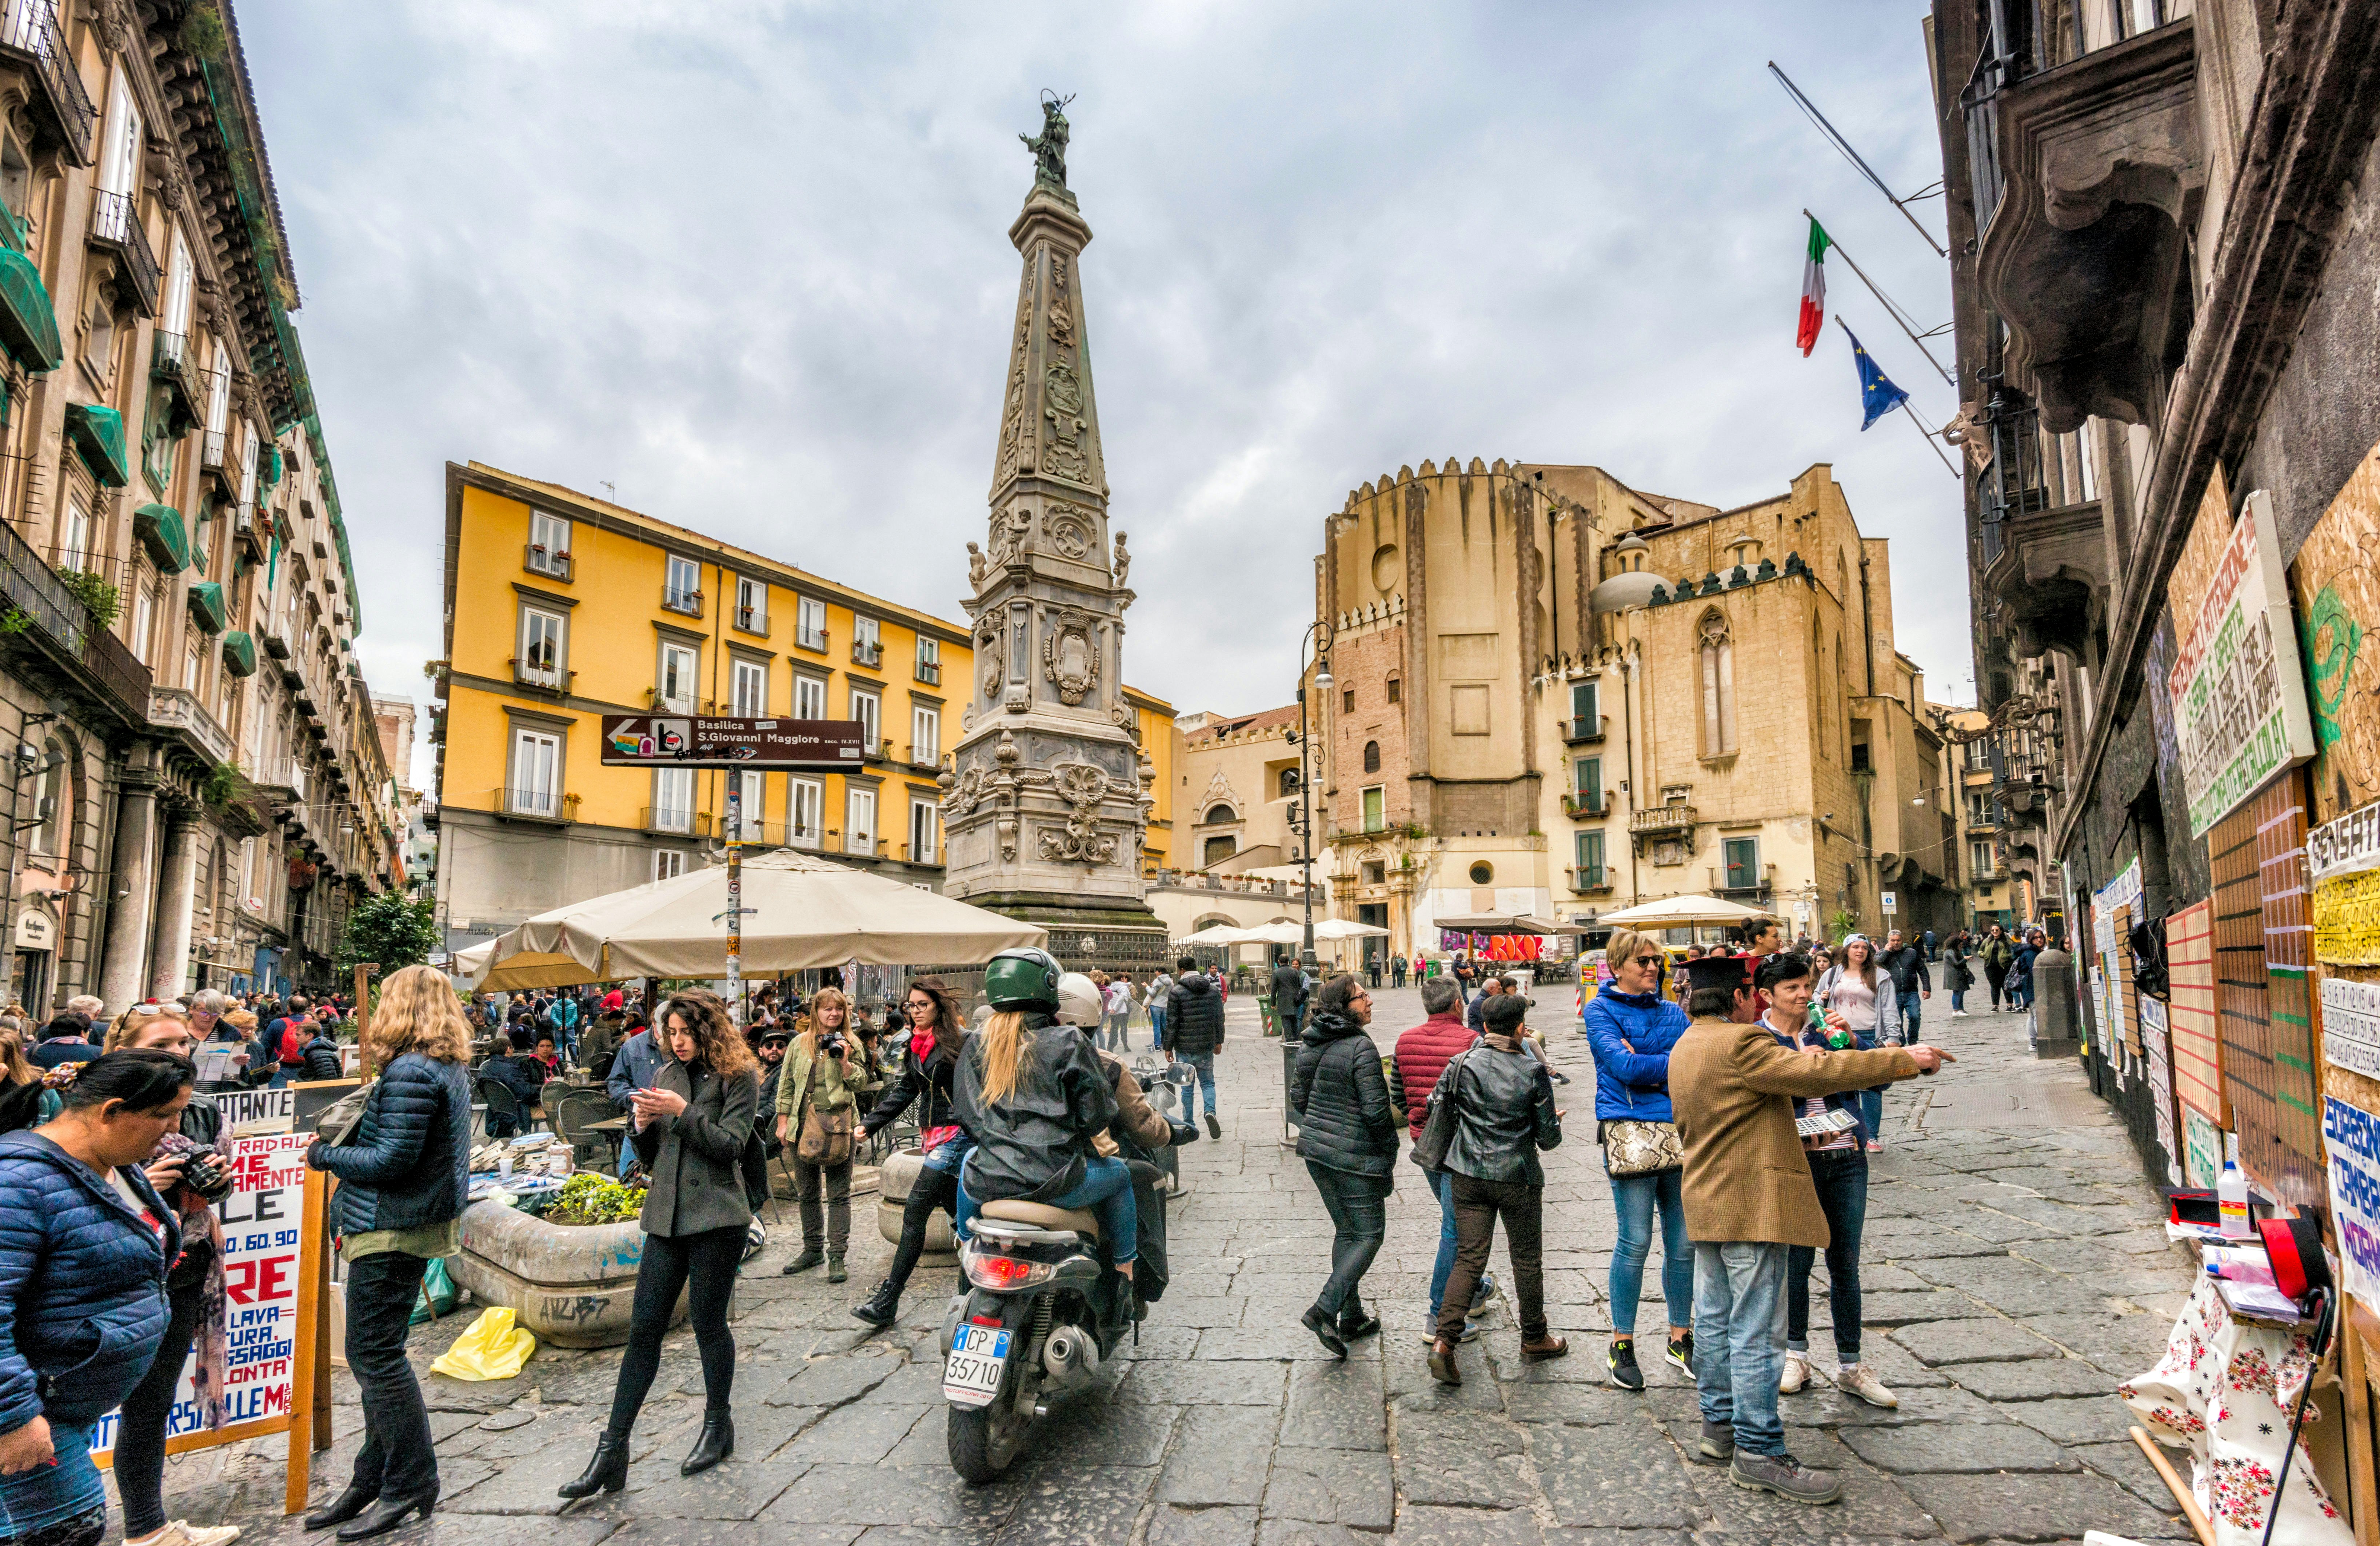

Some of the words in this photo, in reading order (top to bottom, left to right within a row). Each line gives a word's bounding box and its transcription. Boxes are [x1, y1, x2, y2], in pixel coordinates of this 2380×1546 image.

[698, 720, 744, 730] Basilica
[698, 732, 761, 742] S.Giovanni
[767, 734, 819, 745] Maggiore
[2350, 987, 2356, 1008] 12
[2370, 1022, 2377, 1043] 36
[967, 1329, 988, 1351] CP
[948, 1356, 999, 1385] 35710
[945, 1387, 979, 1397] MOTOFFICINA
